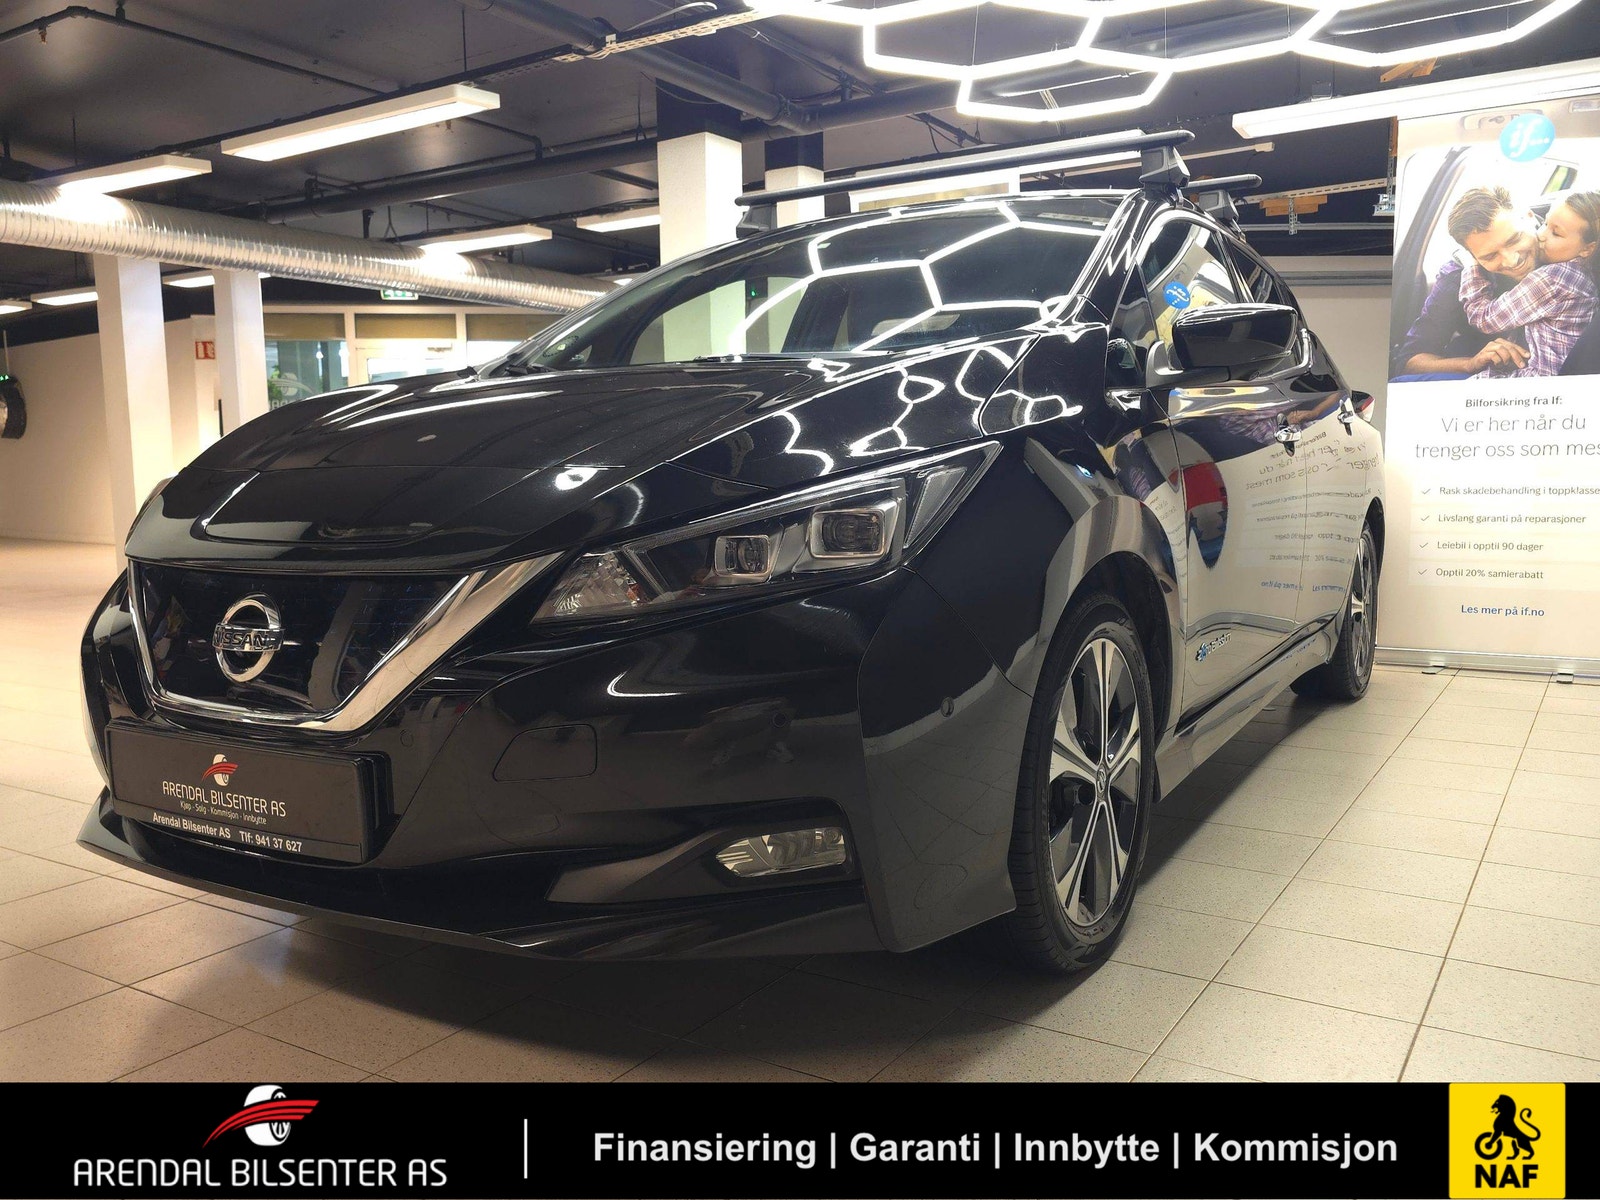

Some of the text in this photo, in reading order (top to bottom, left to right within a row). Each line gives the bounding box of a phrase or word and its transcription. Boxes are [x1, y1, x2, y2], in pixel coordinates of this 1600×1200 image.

[1465, 397, 1530, 408] Bilforsikring
[1533, 396, 1548, 406] fra
[1441, 414, 1586, 433] Vi er her når du
[1415, 443, 1480, 461] trenger
[1485, 444, 1515, 457] oss
[1520, 443, 1559, 457] som
[1439, 486, 1461, 495] Rask
[1463, 486, 1541, 496] skadebehandling
[1548, 486, 1600, 496] toppklasse
[1438, 514, 1587, 524] Livslang garanti på reparasjoner
[1437, 541, 1466, 550] Leiebil
[1473, 542, 1500, 551] opptil
[1502, 542, 1515, 551] 90
[1516, 542, 1544, 552] dager
[1435, 567, 1464, 577] Opptil
[1465, 569, 1486, 577] 20%
[1461, 605, 1545, 617] Les mer på if.no
[162, 781, 287, 817] ARENDAL BILSENTER AS
[153, 812, 302, 852] Arendal Bilsenter AS Tlf: 941 37 627
